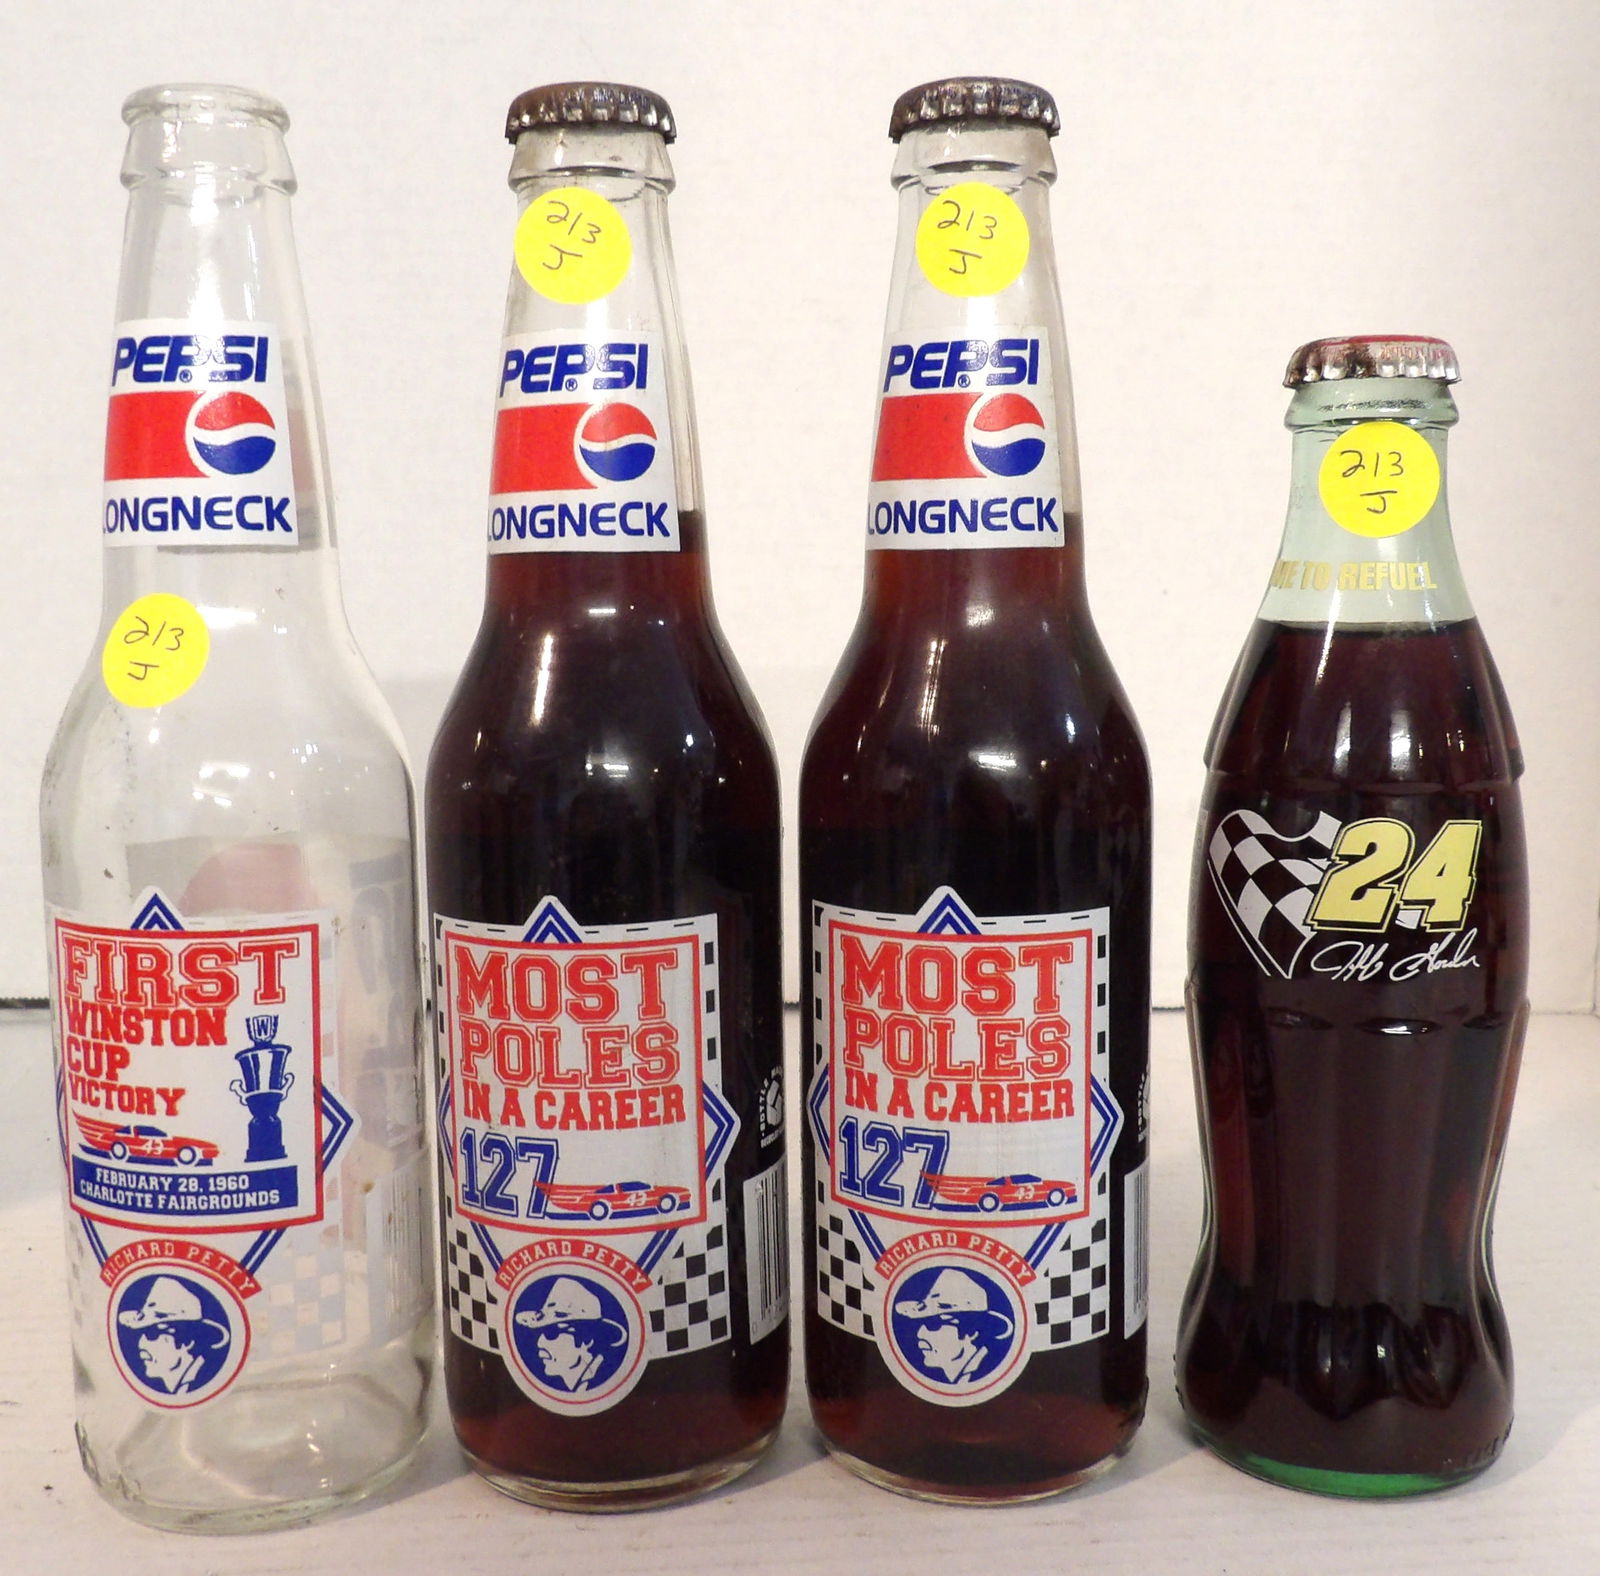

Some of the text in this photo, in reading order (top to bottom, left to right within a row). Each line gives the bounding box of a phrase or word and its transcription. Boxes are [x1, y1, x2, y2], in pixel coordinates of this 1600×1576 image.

[545, 200, 602, 244] 213
[937, 200, 998, 240] 213
[111, 335, 269, 387] PEPSI
[499, 343, 649, 399] PEPSI
[883, 338, 1040, 393] PEPSI
[1339, 449, 1405, 478] 213
[103, 495, 293, 534] ONGNECK
[1360, 489, 1398, 515] J
[1300, 560, 1333, 591] TO
[1336, 560, 1439, 591] REFUEL
[123, 616, 184, 651] 213
[127, 661, 160, 681] J
[1302, 816, 1483, 934] 24
[61, 932, 300, 1008] FIRST
[454, 945, 679, 1024] MOST
[840, 934, 1074, 1016] MOST
[65, 995, 228, 1047] WINSTON
[842, 1003, 1073, 1083] POLES
[66, 1035, 131, 1082] CUP
[459, 1015, 681, 1090] POLES
[67, 1071, 187, 1117] VICTORY
[462, 1077, 687, 1131] IN A CAREER
[844, 1067, 1075, 1124] IN A CAREER
[95, 1167, 173, 1192] FEBRUARY
[208, 1175, 250, 1192] 1960
[459, 1126, 561, 1220] 127
[838, 1115, 950, 1211] 127
[79, 1179, 280, 1210] CHARLOTTE FAIRGROUNDS
[624, 1191, 648, 1207] 43
[1015, 1183, 1036, 1201] 43
[102, 1241, 255, 1291] RICHARD PETTY
[499, 1240, 648, 1288] RICHARD PETTY
[879, 1231, 1032, 1282] RICHARD PETTY
